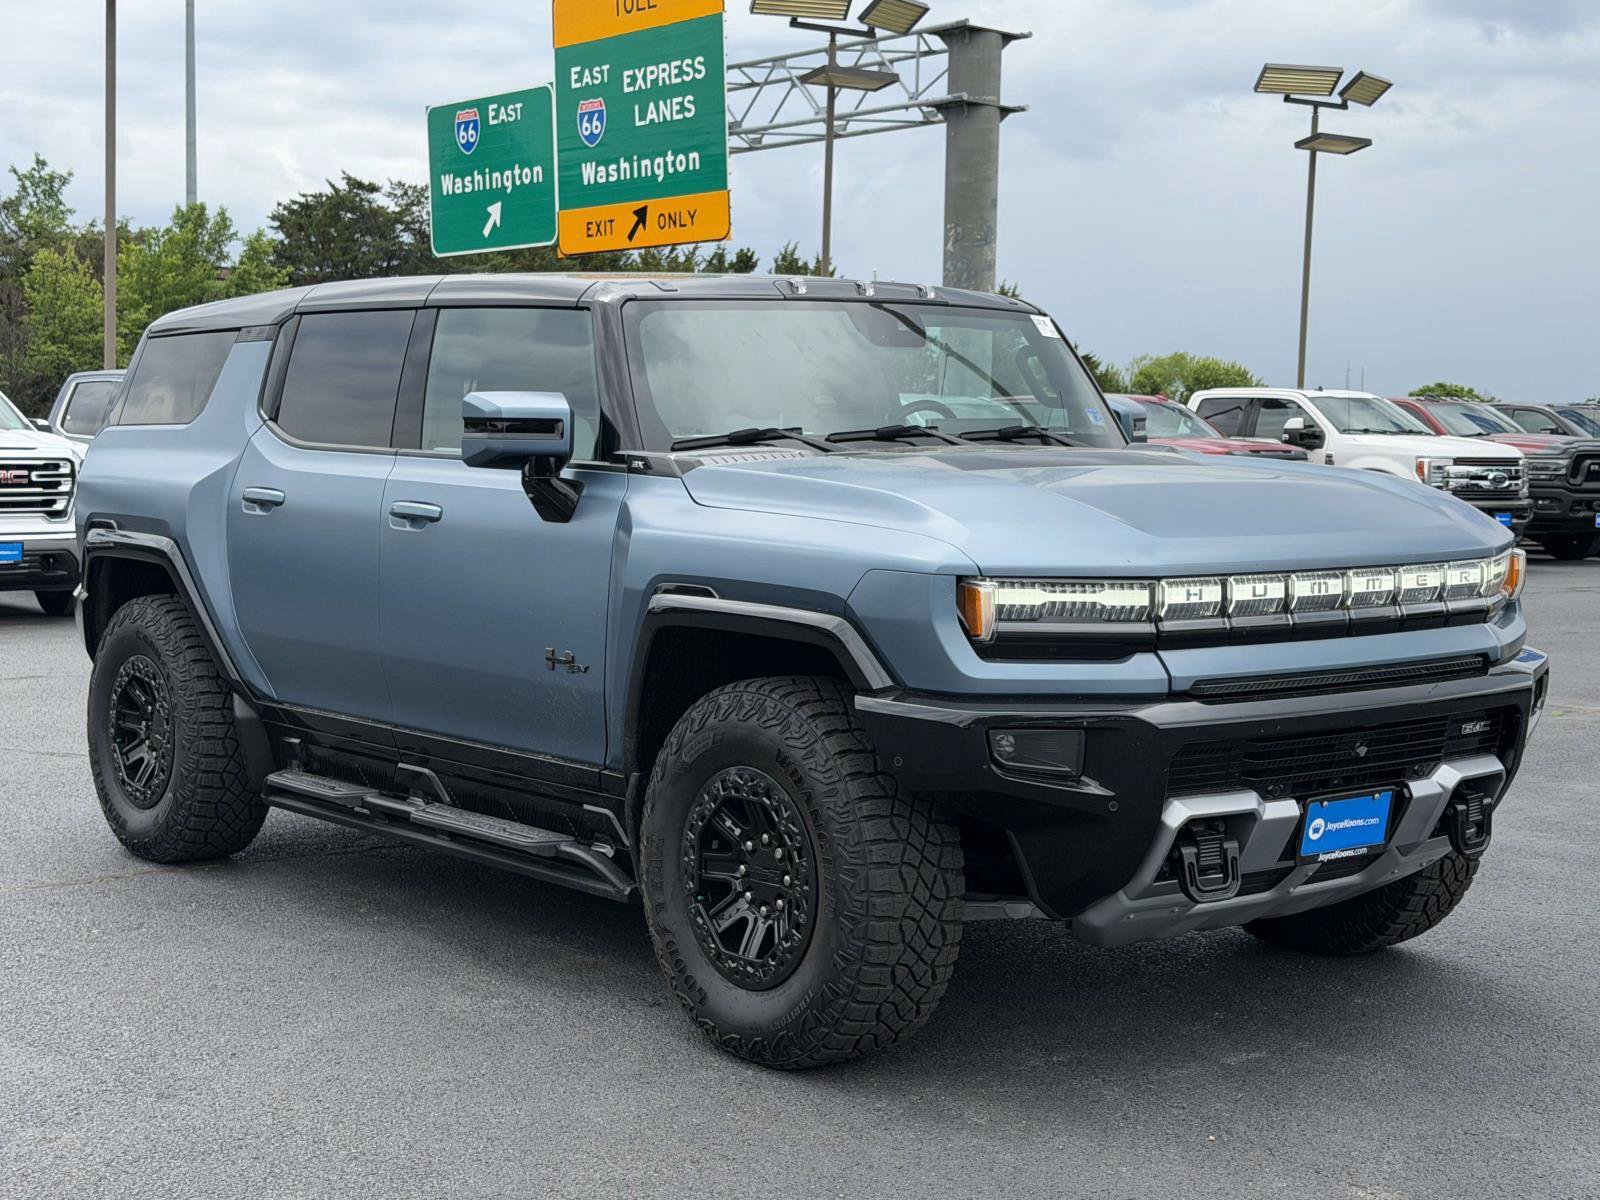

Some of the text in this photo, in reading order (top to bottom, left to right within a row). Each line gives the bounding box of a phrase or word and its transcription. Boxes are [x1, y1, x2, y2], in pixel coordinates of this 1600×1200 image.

[571, 64, 610, 89] EAST
[623, 56, 706, 93] EXPRESS
[488, 103, 523, 126] EAST
[581, 113, 602, 137] 66
[635, 96, 696, 127] LANES
[459, 122, 477, 145] 66
[441, 164, 543, 196] Washington
[581, 150, 700, 186] Washington
[586, 209, 698, 238] EXIT ONLY
[1325, 817, 1380, 832] JoyceKoons.com
